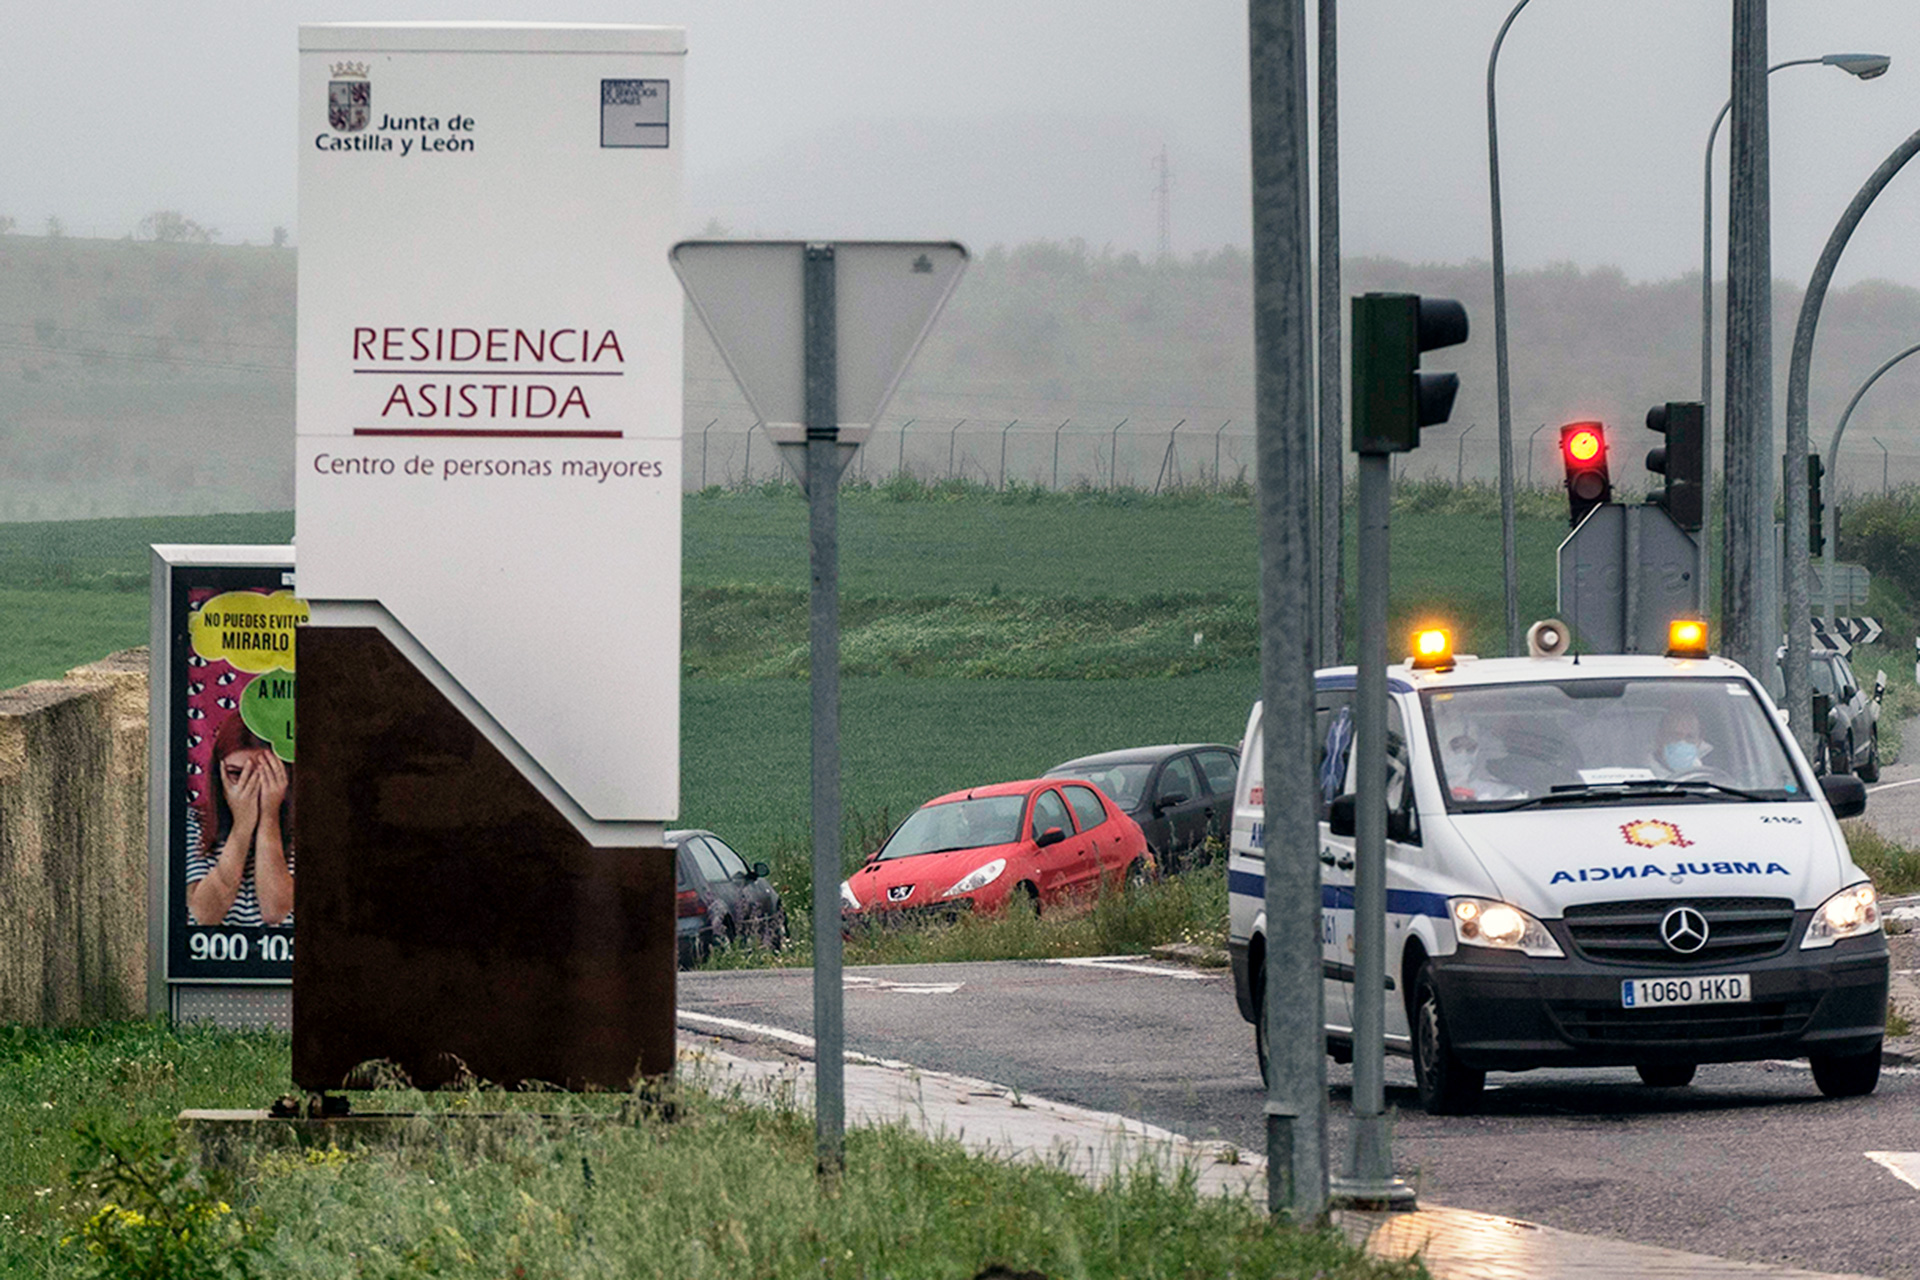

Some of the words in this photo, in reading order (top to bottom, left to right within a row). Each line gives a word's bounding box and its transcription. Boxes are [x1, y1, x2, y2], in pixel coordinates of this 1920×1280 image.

[378, 114, 439, 131] Junta
[447, 114, 475, 131] de
[315, 133, 392, 151] Castilla
[400, 138, 413, 157] y
[421, 134, 474, 151] León
[353, 328, 624, 362] RESIDENCIA
[381, 384, 590, 418] ASISTIDA
[314, 453, 395, 475] Centro
[404, 455, 434, 475] de
[443, 458, 552, 481] personas
[562, 460, 663, 484] mayores
[204, 612, 220, 628] NO
[223, 613, 267, 629] PUEDES
[222, 632, 289, 651] MIRARLO
[258, 679, 269, 699] A
[272, 679, 295, 699] MI
[190, 932, 249, 961] 900
[1641, 981, 1692, 1003] 1060
[1700, 978, 1741, 1000] HKD
